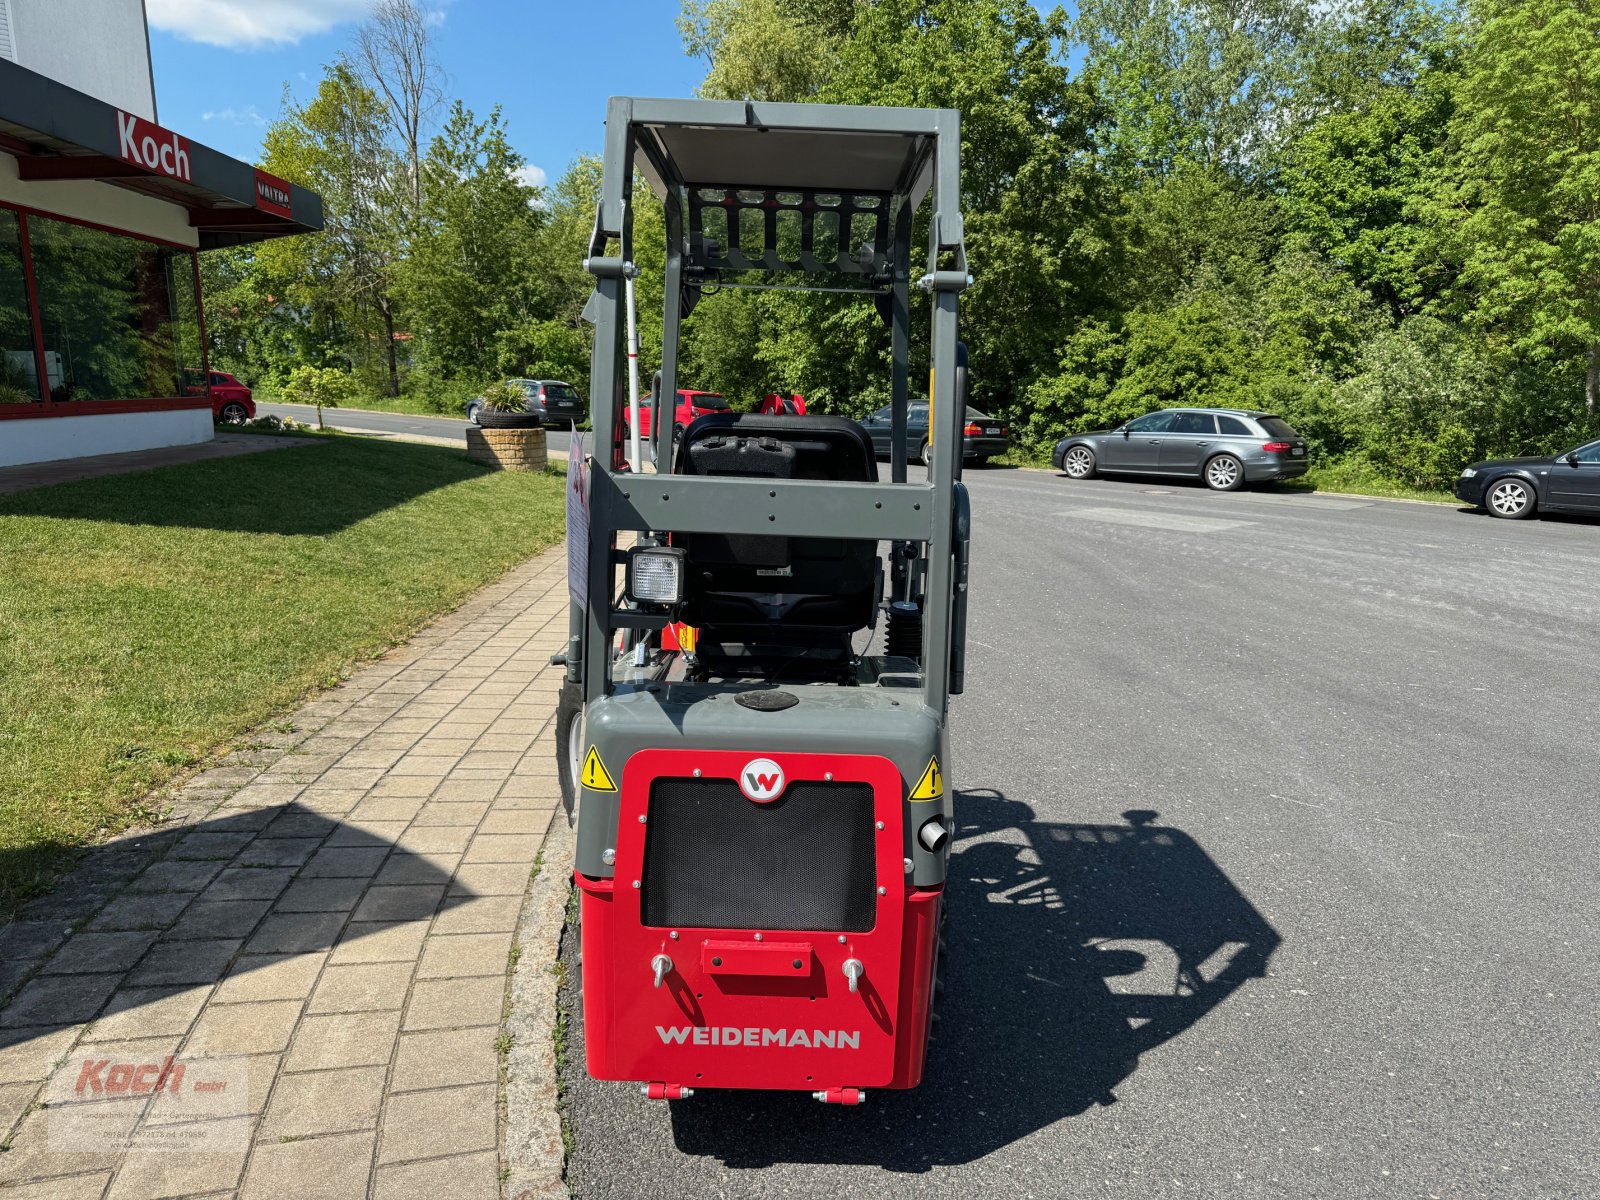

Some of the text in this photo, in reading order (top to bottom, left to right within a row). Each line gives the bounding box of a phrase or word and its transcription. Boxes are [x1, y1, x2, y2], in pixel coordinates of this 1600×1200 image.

[117, 110, 191, 181] Koch
[257, 180, 289, 203] VALTRA
[655, 1026, 860, 1049] WEIDEMANN
